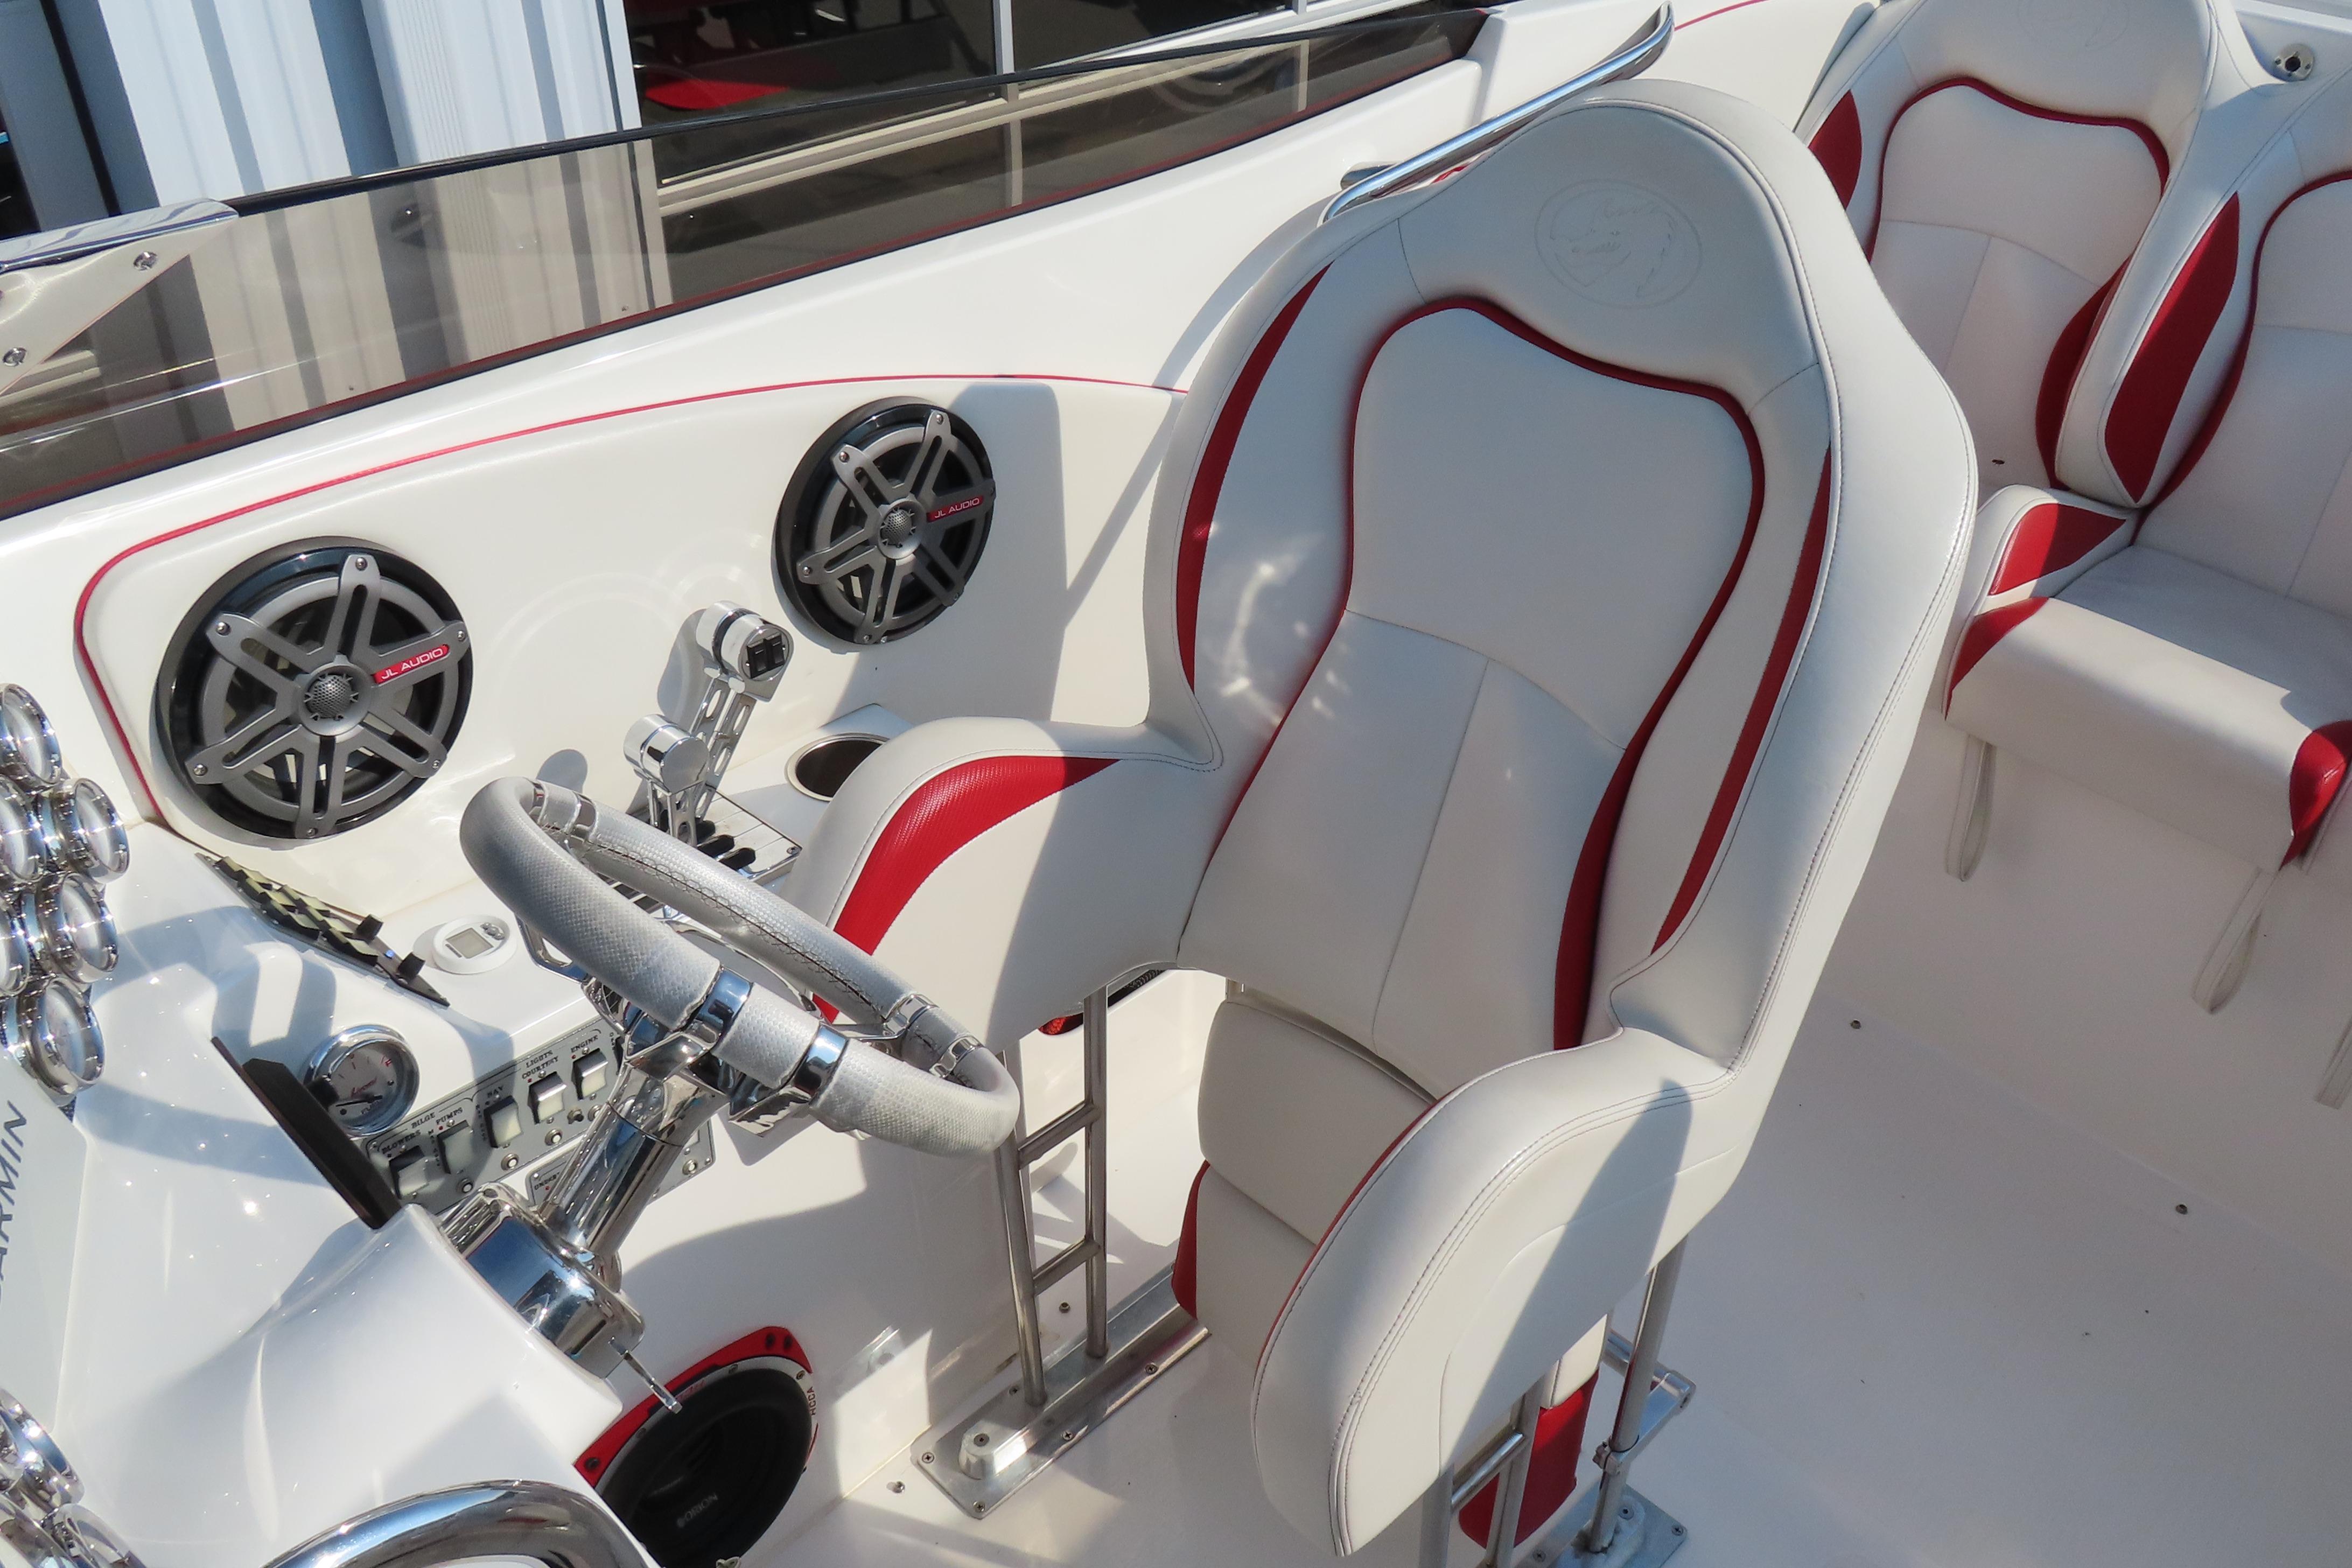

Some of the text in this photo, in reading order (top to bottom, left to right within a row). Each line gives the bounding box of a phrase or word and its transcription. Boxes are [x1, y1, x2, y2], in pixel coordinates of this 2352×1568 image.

[934, 498, 980, 518] JL AUDIO
[381, 648, 443, 680] JL AUDIO
[571, 1034, 599, 1053] ENGINE
[526, 1050, 553, 1068] LIGHTS
[487, 1086, 503, 1097] NAV
[411, 1112, 436, 1129] BILGE
[436, 1107, 463, 1125] PUMPS
[381, 1130, 421, 1154] BLOWERS
[807, 1386, 816, 1416] HCCA
[684, 1493, 718, 1521] ORION
